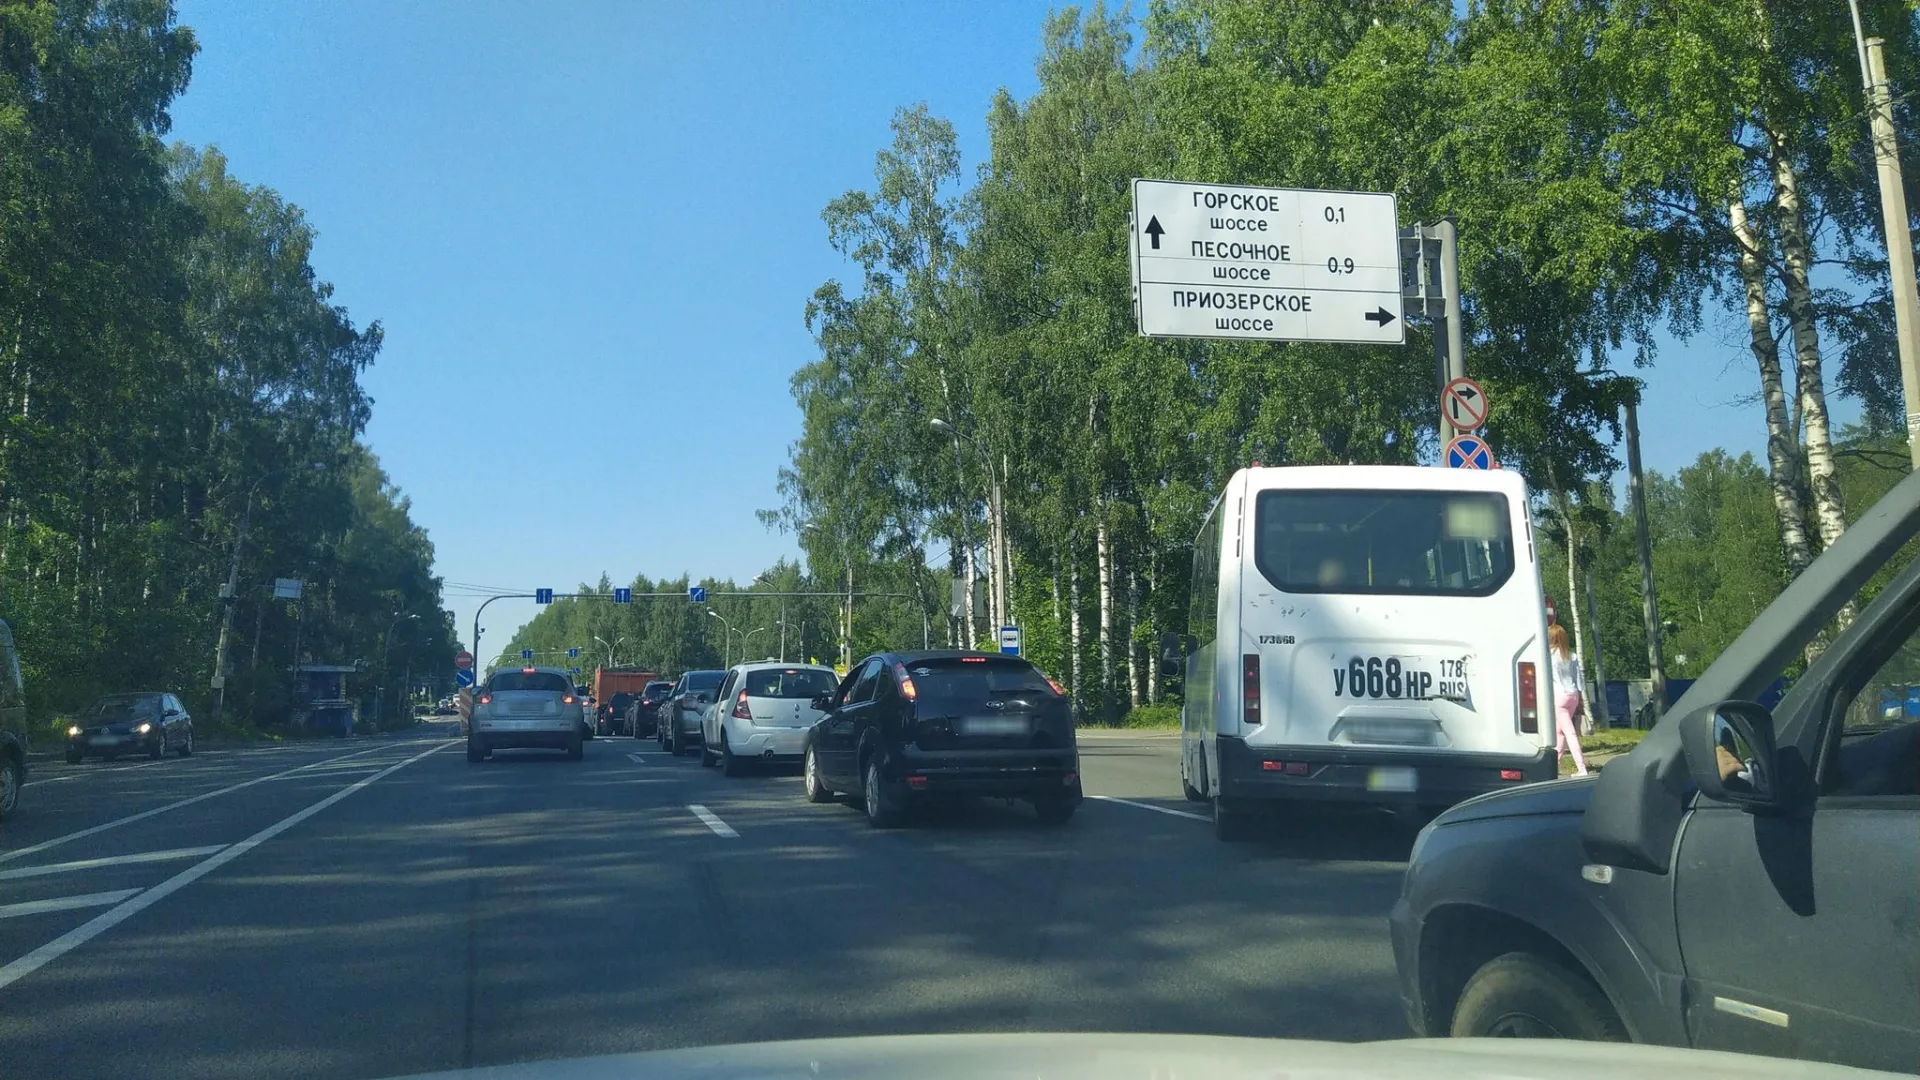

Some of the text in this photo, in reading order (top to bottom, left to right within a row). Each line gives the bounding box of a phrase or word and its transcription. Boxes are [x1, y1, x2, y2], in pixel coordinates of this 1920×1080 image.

[1193, 191, 1280, 212] ГОРСКОЕ
[1324, 206, 1345, 223] 0,1
[1210, 217, 1268, 232] шоссе
[1191, 240, 1291, 262] ПЕСОЧНОЕ
[1213, 266, 1271, 281] шоссе
[1327, 257, 1355, 274] 0,9
[1173, 290, 1312, 312] ПРИОЗЕРСКОЕ
[1215, 317, 1274, 332] шоссе
[1439, 659, 1463, 678] 178
[1439, 681, 1466, 697] RUS
